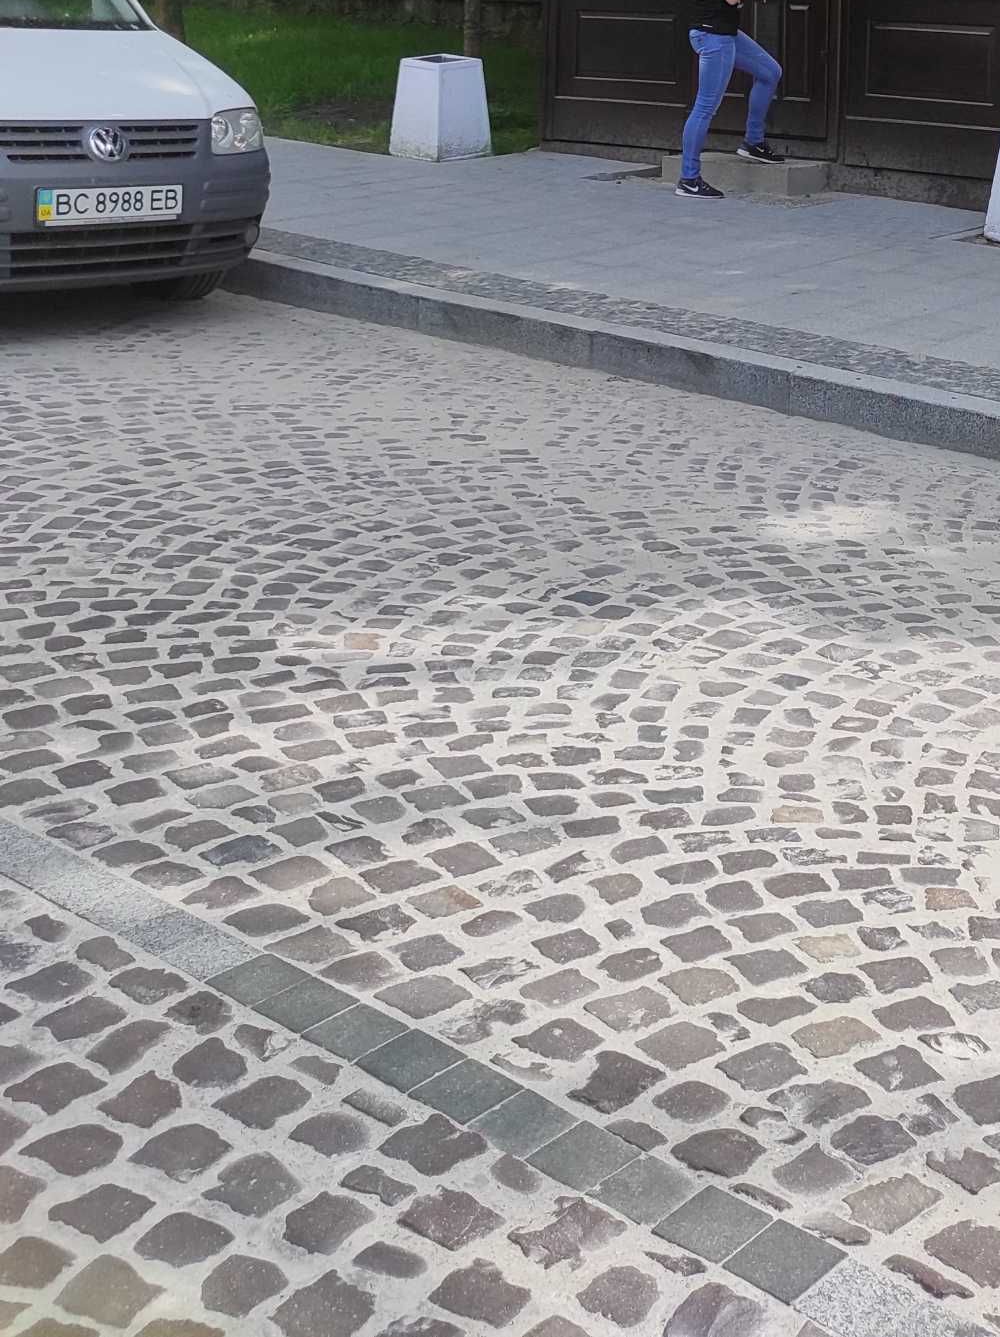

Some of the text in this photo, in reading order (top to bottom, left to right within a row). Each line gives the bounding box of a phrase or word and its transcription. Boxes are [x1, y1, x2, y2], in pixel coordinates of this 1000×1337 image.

[56, 189, 178, 216] BC 8988 EB
